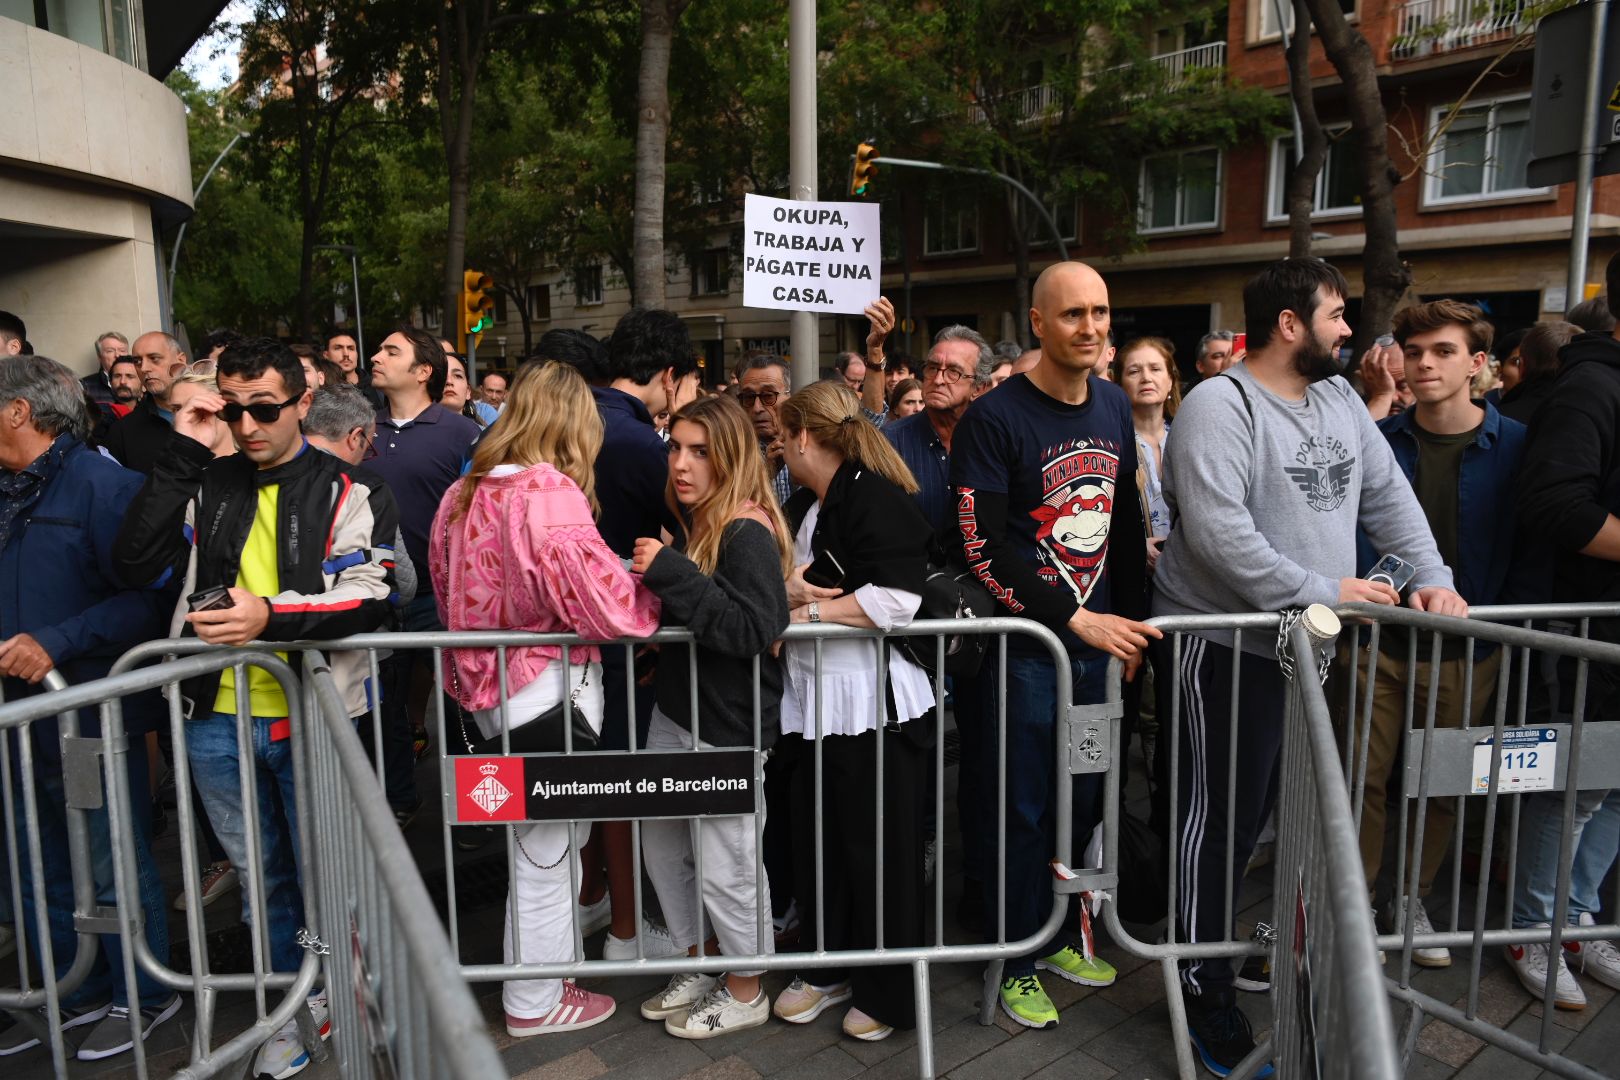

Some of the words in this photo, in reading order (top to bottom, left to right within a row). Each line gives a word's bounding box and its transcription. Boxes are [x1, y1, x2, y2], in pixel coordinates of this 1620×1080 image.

[773, 207, 848, 229] OKUPA,
[753, 230, 844, 252] TRABAJA
[851, 238, 865, 252] Y
[746, 255, 821, 277] PÁGATE
[828, 263, 872, 280] UNA
[772, 286, 834, 304] CASA.
[1044, 458, 1080, 490] NINJA
[531, 780, 631, 799] Ajuntament
[636, 778, 657, 793] de
[662, 776, 748, 793] Barcelona
